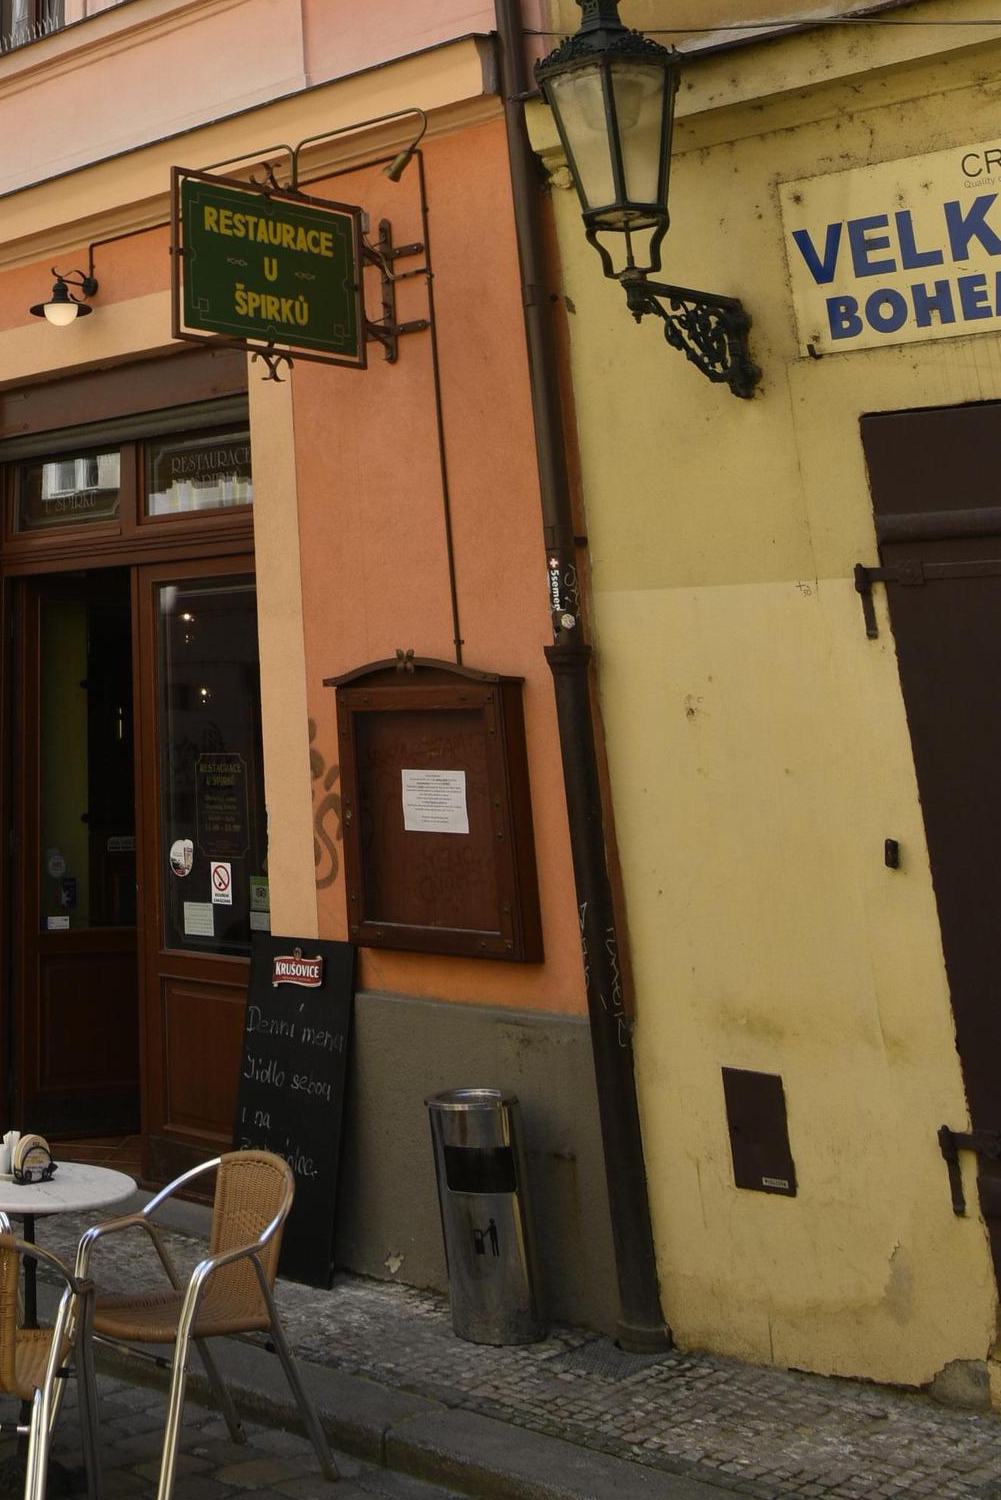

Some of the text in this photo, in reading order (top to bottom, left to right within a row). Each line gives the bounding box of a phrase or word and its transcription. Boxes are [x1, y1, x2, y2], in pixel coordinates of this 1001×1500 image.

[963, 177, 996, 189] Quality
[203, 205, 334, 258] RESTAURACE
[263, 257, 278, 282] U
[234, 282, 309, 326] ŠPIRKŮ
[826, 271, 1001, 341] BOHE
[275, 961, 320, 979] KRUŠOVICE
